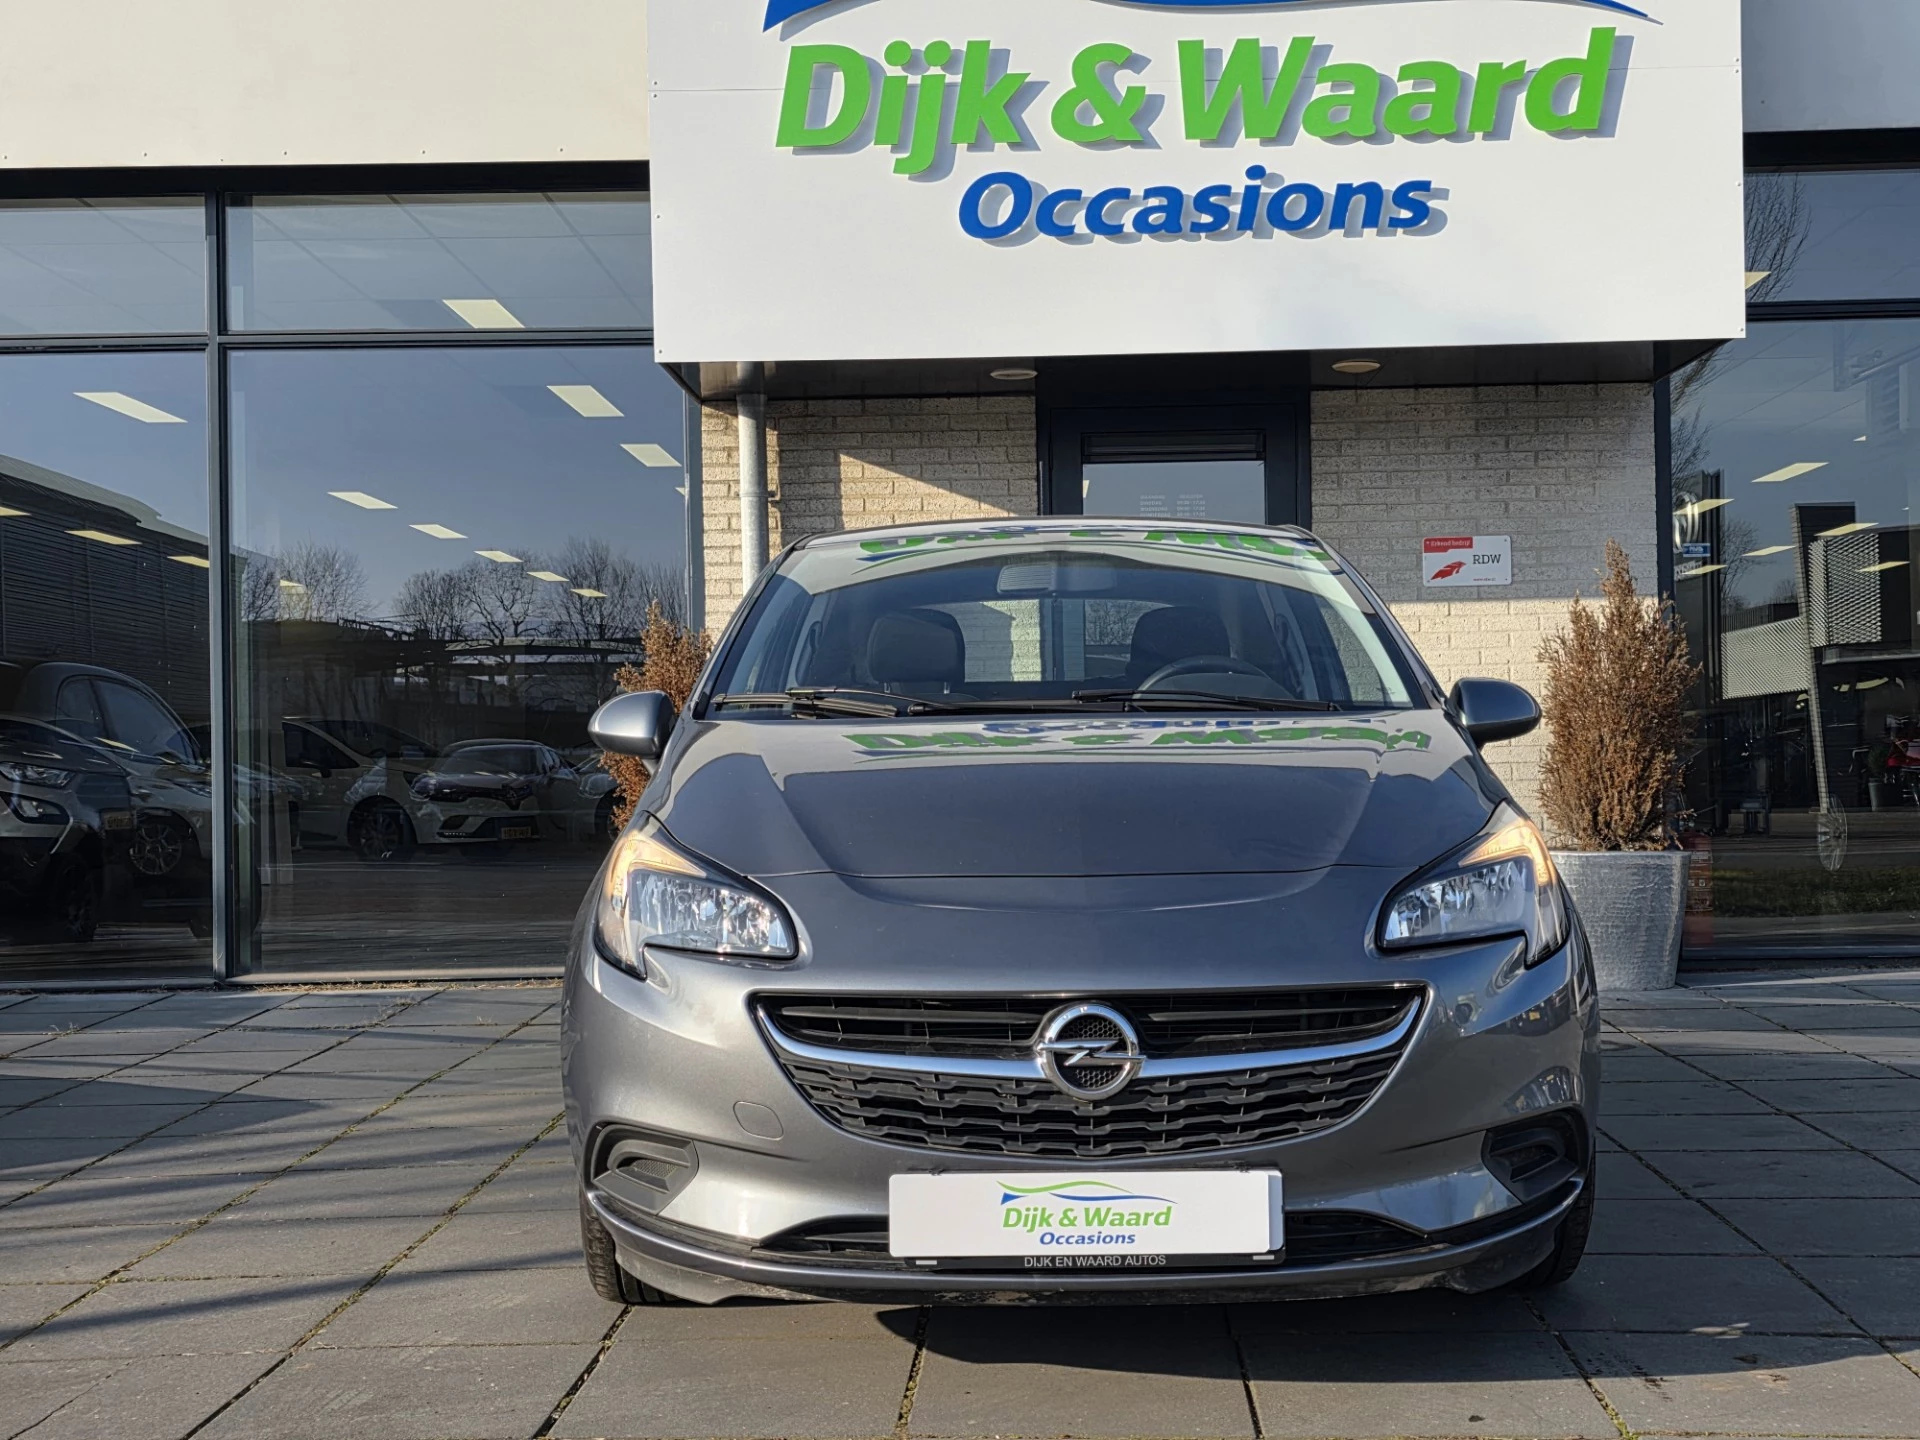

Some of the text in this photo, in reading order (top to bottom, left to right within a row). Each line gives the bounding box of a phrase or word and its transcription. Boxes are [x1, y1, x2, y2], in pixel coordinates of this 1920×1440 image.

[776, 27, 1616, 175] Dijk & Waard
[958, 165, 1432, 239] Occasions
[1472, 554, 1502, 565] RDW
[1003, 1205, 1172, 1232] Dijk & Waard
[1039, 1231, 1136, 1246] Occasions
[1024, 1255, 1166, 1267] DIJK EN WAARD AUTOS
